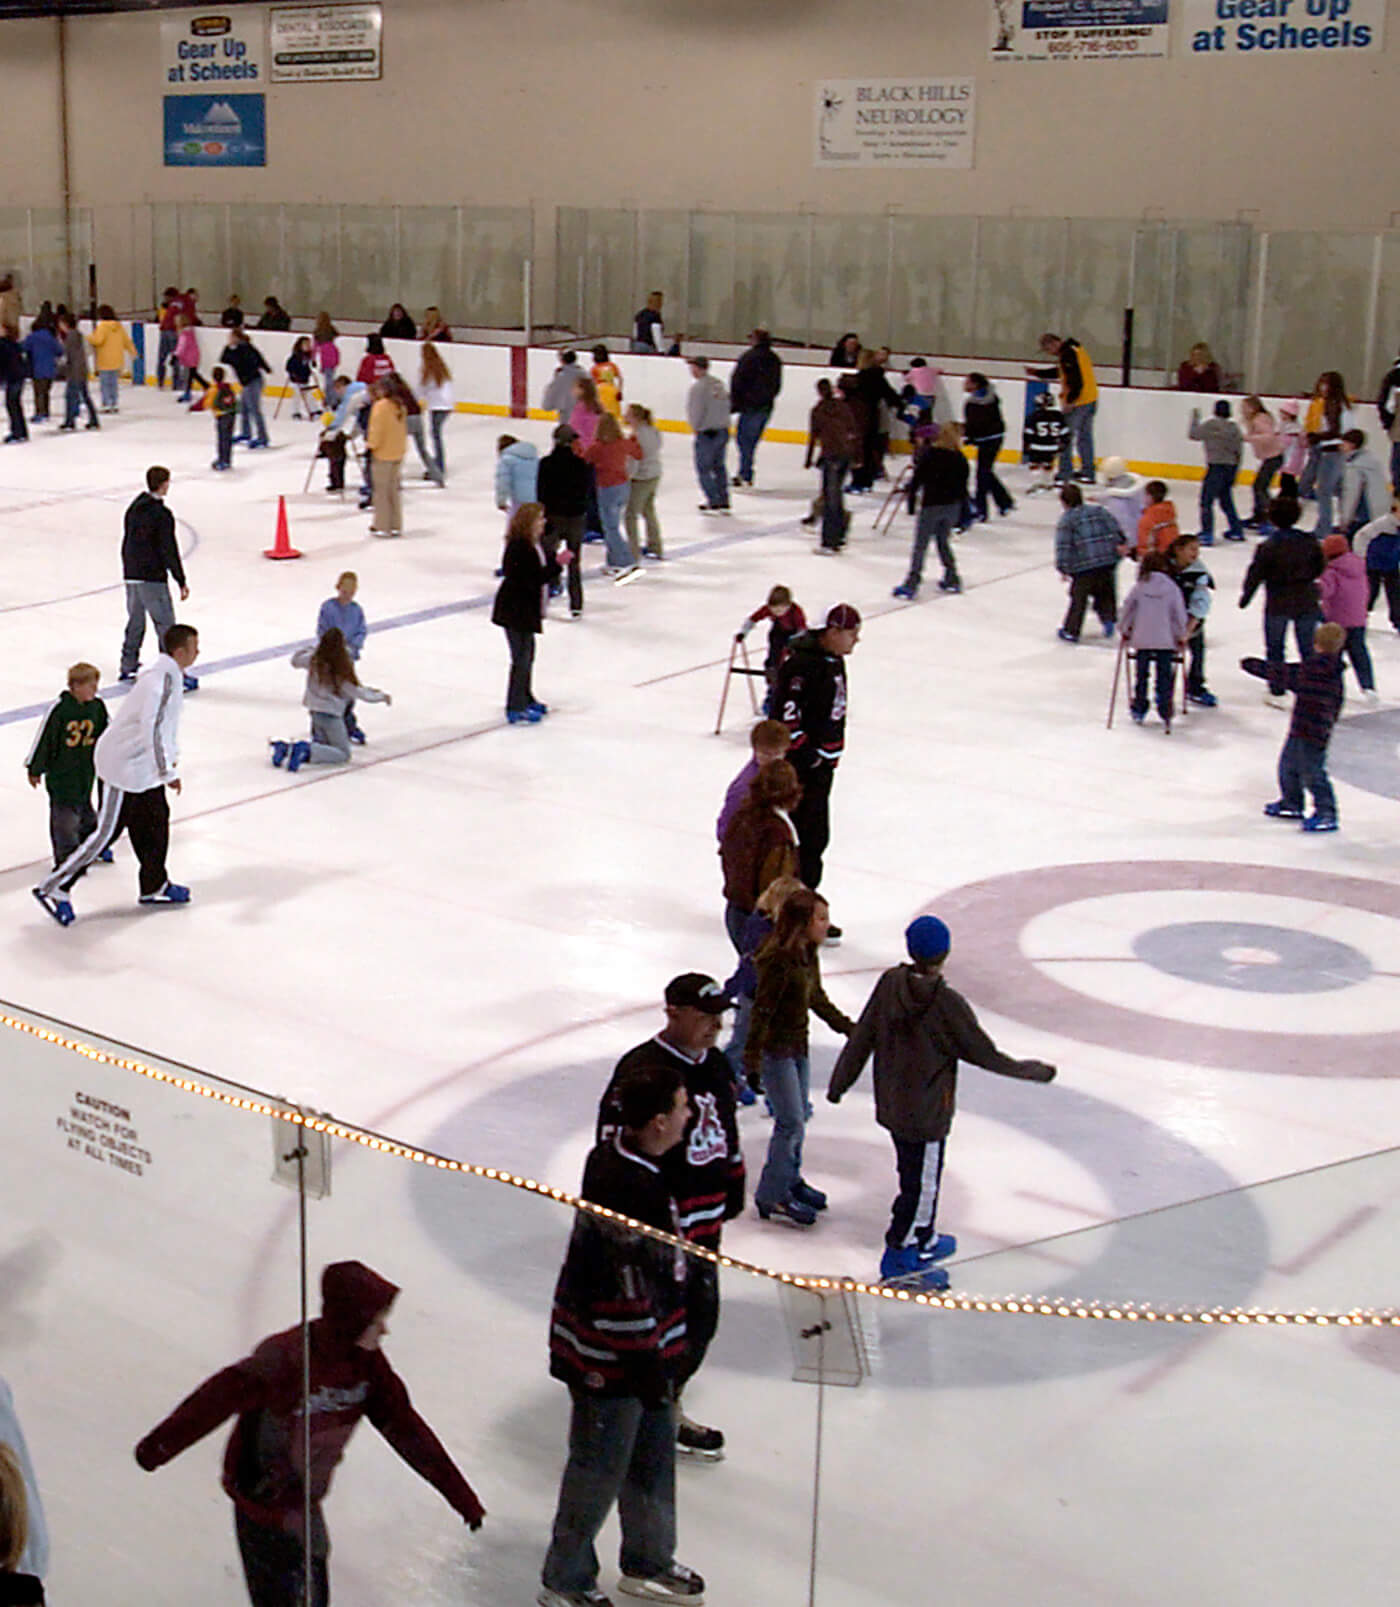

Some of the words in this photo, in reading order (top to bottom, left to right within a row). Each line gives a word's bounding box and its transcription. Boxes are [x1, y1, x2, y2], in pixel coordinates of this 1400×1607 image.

[1216, 0, 1293, 19] Gear
[1306, 0, 1351, 21] Up
[1035, 31, 1068, 40] STOP
[1074, 28, 1153, 39] SUFFERING!
[1193, 26, 1225, 51] at
[1237, 21, 1372, 50] Scheels
[178, 40, 216, 60] Gear
[224, 38, 246, 60] Up
[168, 64, 184, 82] at
[190, 61, 258, 81] Scheels
[856, 86, 913, 101] BLACK
[919, 85, 970, 101] HILLS
[856, 108, 968, 124] NEUROLOGY
[1036, 421, 1061, 437] 55
[66, 719, 95, 748] 32
[75, 1091, 131, 1122] CAUTION
[70, 1107, 111, 1130] WATCH
[114, 1122, 138, 1141] FOR
[56, 1117, 96, 1142] FLYING
[100, 1134, 152, 1164] OBJECTS
[68, 1138, 81, 1150] AT
[85, 1144, 104, 1162] ALL
[109, 1153, 143, 1176] TIMES
